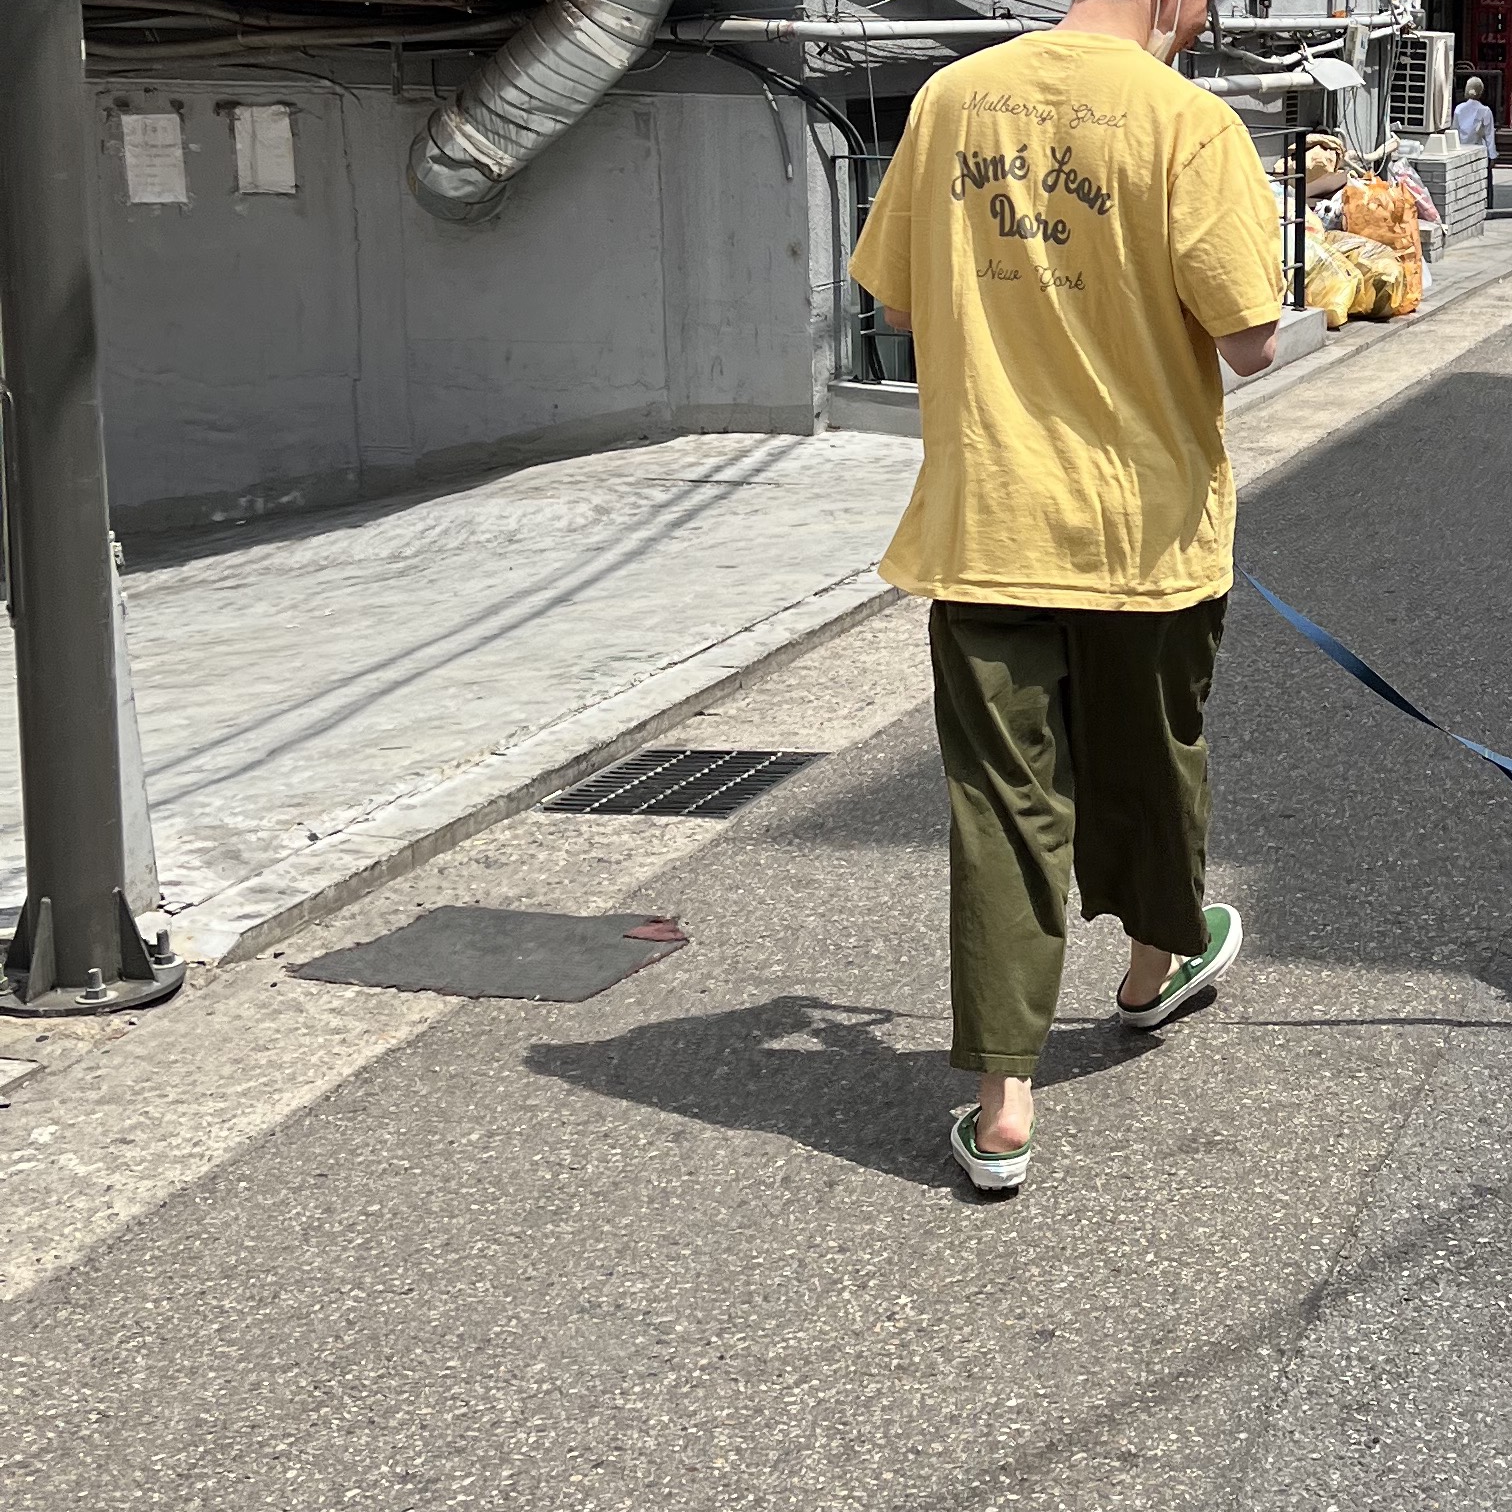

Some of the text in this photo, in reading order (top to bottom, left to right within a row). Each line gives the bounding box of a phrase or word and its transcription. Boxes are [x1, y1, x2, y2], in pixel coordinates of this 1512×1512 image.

[961, 90, 1128, 130] Mulberry Street
[951, 143, 1116, 216] Aimé Leon
[989, 193, 1072, 246] Dore
[976, 258, 1087, 292] New York
